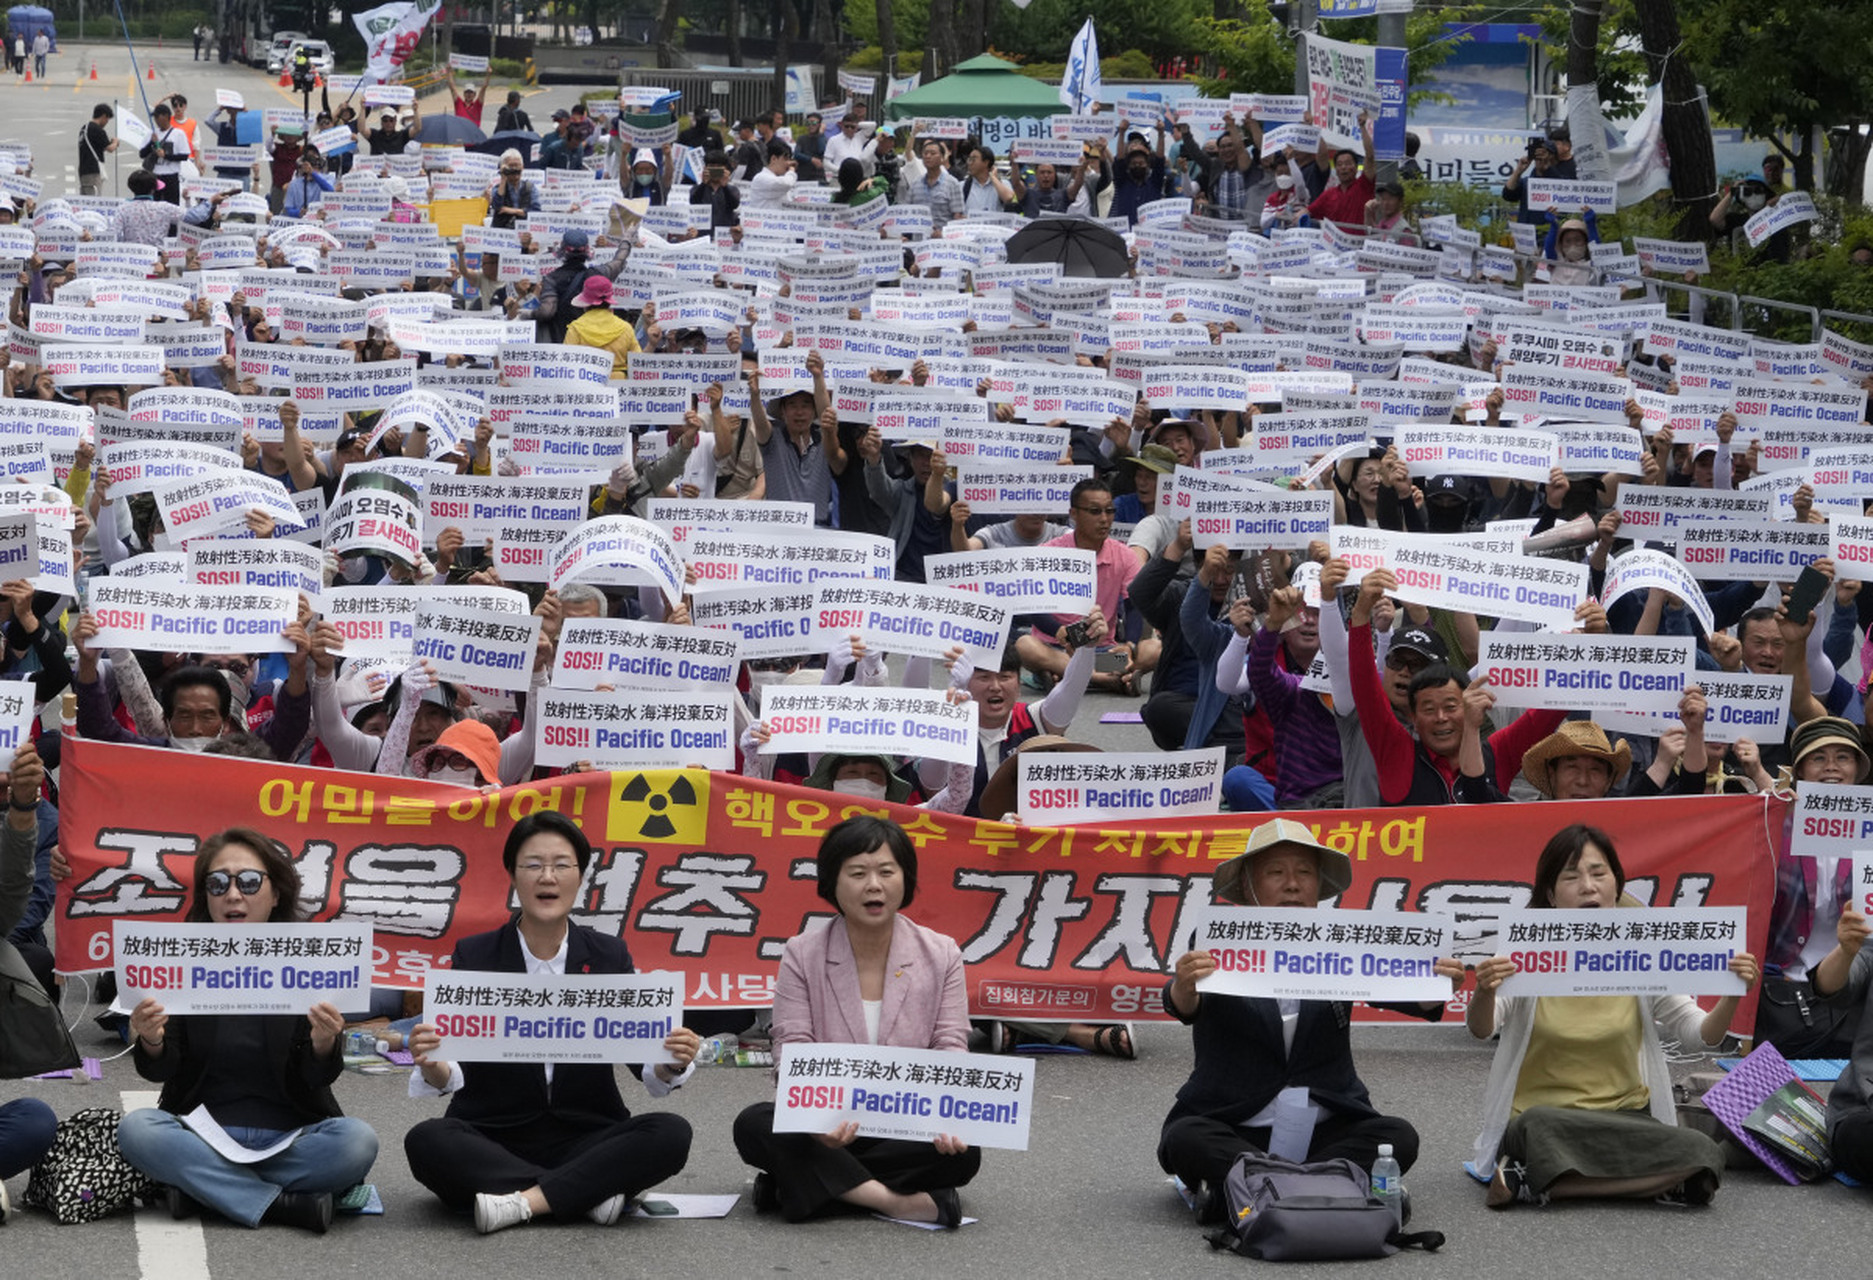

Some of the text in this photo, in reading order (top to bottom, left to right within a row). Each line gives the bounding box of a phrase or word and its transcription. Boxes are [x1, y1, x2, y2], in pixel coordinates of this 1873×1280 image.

[1406, 446, 1551, 468] SOS!! Pacific Ocean!
[356, 498, 403, 519] 오염수
[431, 501, 581, 521] SOS!! Pacific Ocean!
[1685, 547, 1784, 565] SOS!! Pacific
[693, 562, 803, 584] SOS!! Pacific
[1395, 568, 1576, 610] SOS!! Pacific Ocean!
[819, 588, 1006, 626] 放射性汚染水 海洋投棄反対
[95, 609, 286, 635] SOS!! Pacific Ocean!
[334, 621, 382, 642] SOS!!
[819, 610, 999, 649] SOS!! Pacific Ocean!
[565, 629, 736, 657] 放射性汚染水 海洋投棄反対
[1487, 643, 1687, 664] 放射性汚染水 海洋投棄反対
[563, 651, 732, 681] SOS!! Pacific Ocean!
[1487, 668, 1684, 691] SOS!! Pacific Ocean!
[544, 701, 728, 721] 放射性汚染水 海洋投棄反対
[545, 726, 727, 749] SOS!! Pacific Ocean!
[769, 716, 967, 746] SOS!! Pacific Ocean!
[1027, 760, 1217, 781] 放射性汚染水 海洋投棄反対
[1030, 784, 1213, 808] SOS!! Pacific Ocean!
[1324, 814, 1425, 862] 하여
[1207, 921, 1443, 947] 放射性汚染水 海洋投棄反対
[1508, 921, 1736, 942] 放射性汚染水 海洋投棄反対
[123, 935, 361, 957] 放射性汚染水 海洋投棄反対
[1208, 949, 1265, 972] SOS!!
[1274, 951, 1353, 975] Pacific
[1510, 951, 1567, 974] SOS!!
[1574, 949, 1651, 972] Pacific
[126, 965, 359, 989] SOS!! Pacific Ocean!
[434, 985, 674, 1008] 放射性汚染水 海洋投棄反対
[985, 985, 1089, 1005] 집회참가문의
[434, 1014, 672, 1040] SOS!! Pacific Ocean!
[789, 1058, 1023, 1092] 放射性汚染水 海洋投棄反対
[788, 1086, 1018, 1124] SOS!! Pacific Ocean!
